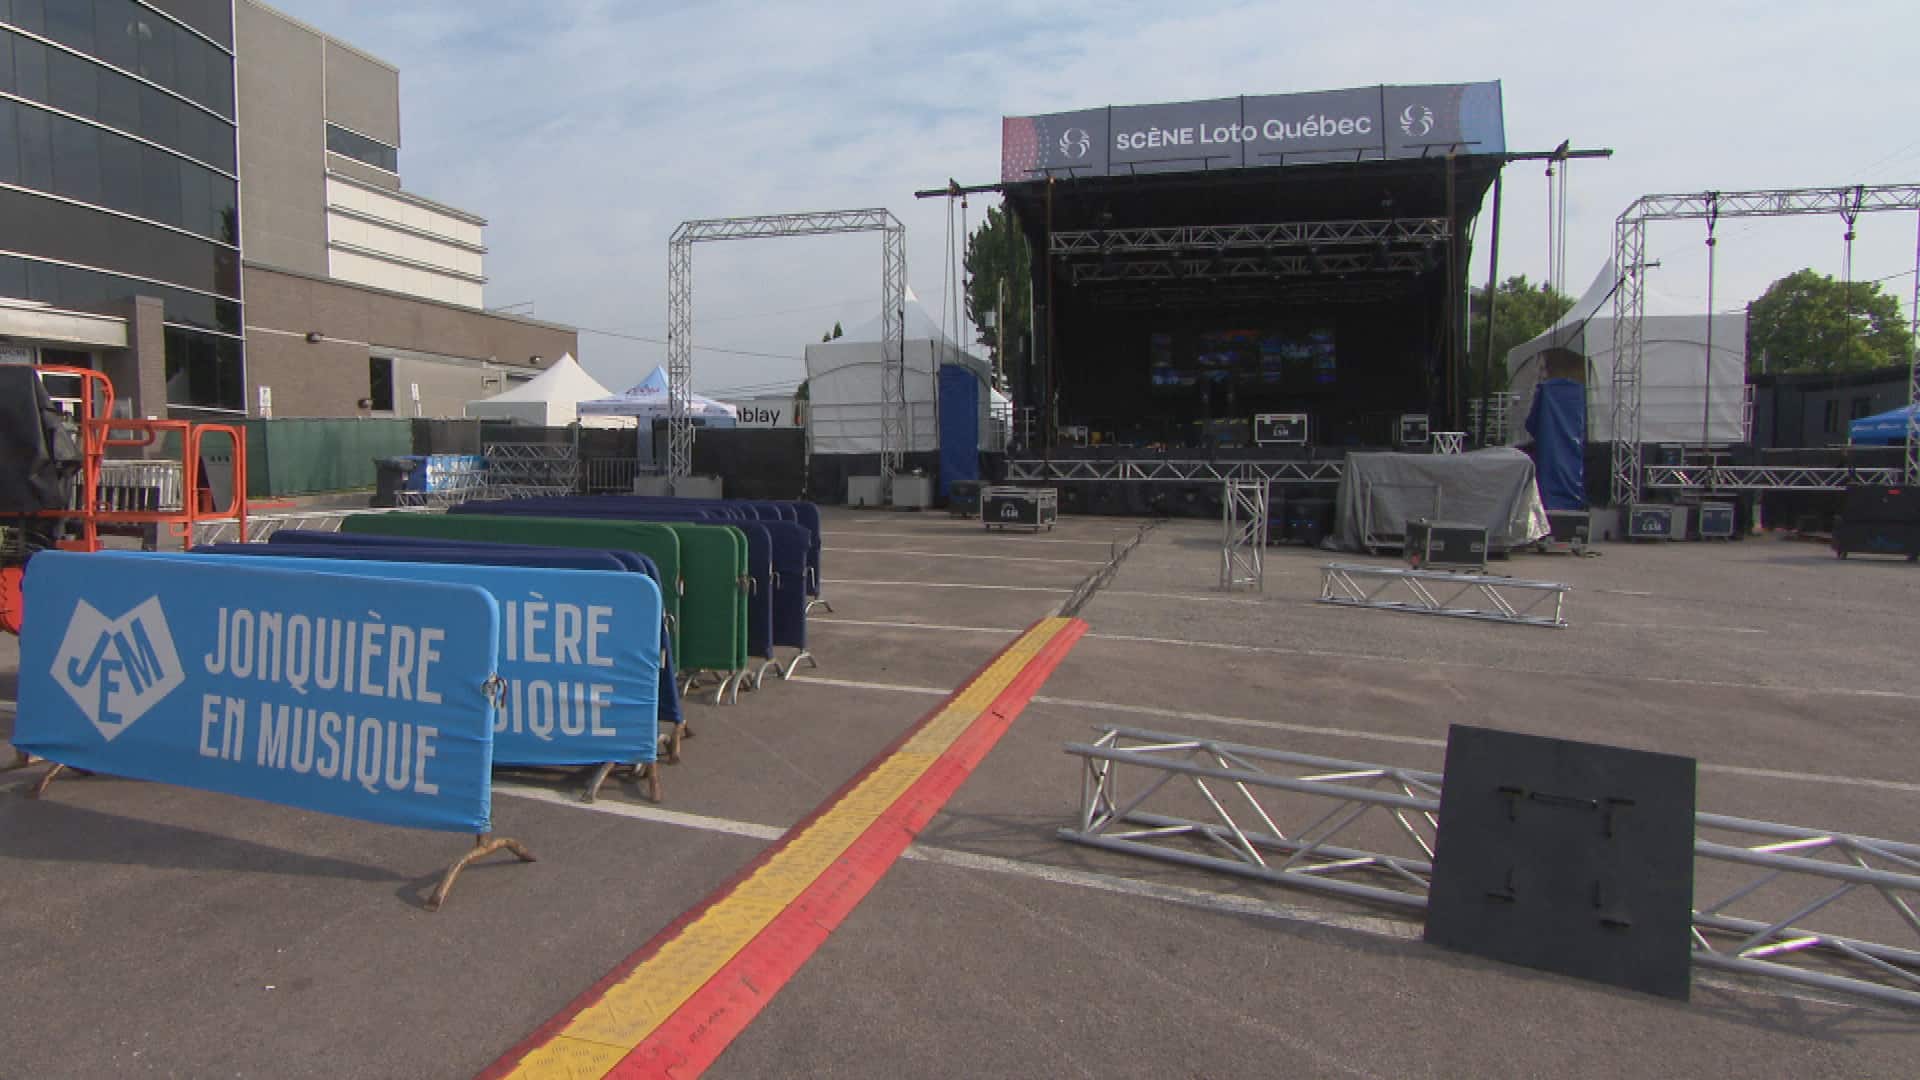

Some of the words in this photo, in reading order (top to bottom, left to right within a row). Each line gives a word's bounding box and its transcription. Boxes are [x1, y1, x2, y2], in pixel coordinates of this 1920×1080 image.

[1116, 126, 1194, 150] SCÈNE
[1199, 123, 1257, 145] Loto
[1262, 114, 1372, 140] Québec
[66, 617, 165, 725] JEM
[204, 607, 446, 703] JONQUIÈRE
[496, 591, 614, 667] IÈRE
[199, 694, 245, 761] EN
[256, 702, 441, 795] MUSIQUE
